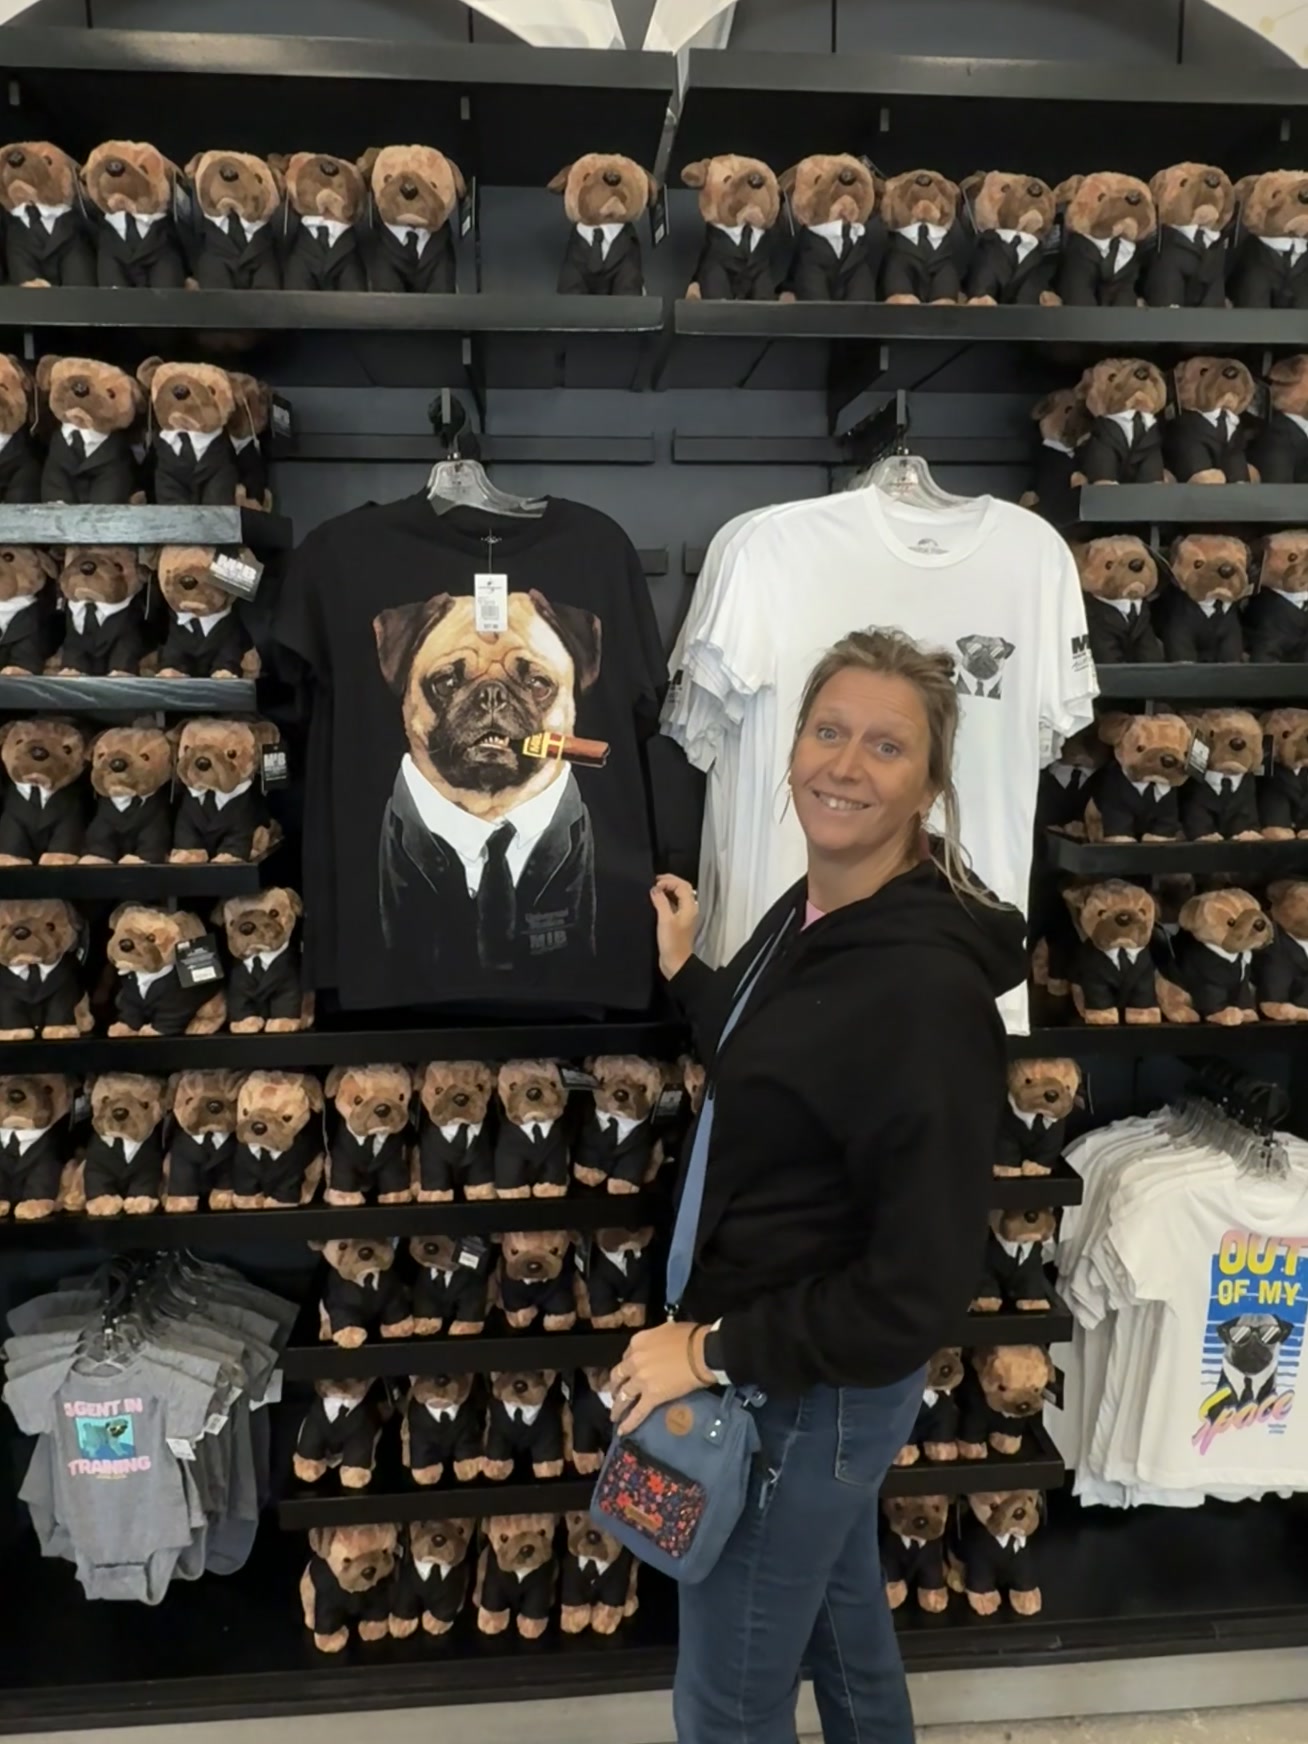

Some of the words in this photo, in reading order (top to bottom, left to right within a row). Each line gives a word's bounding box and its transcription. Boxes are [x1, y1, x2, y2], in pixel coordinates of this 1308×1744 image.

[529, 930, 567, 949] MIB
[1219, 1229, 1308, 1276] OUT
[1217, 1279, 1250, 1306] OF
[1258, 1279, 1301, 1306] MY
[123, 1397, 143, 1414] IN
[67, 1456, 151, 1476] TRAINING
